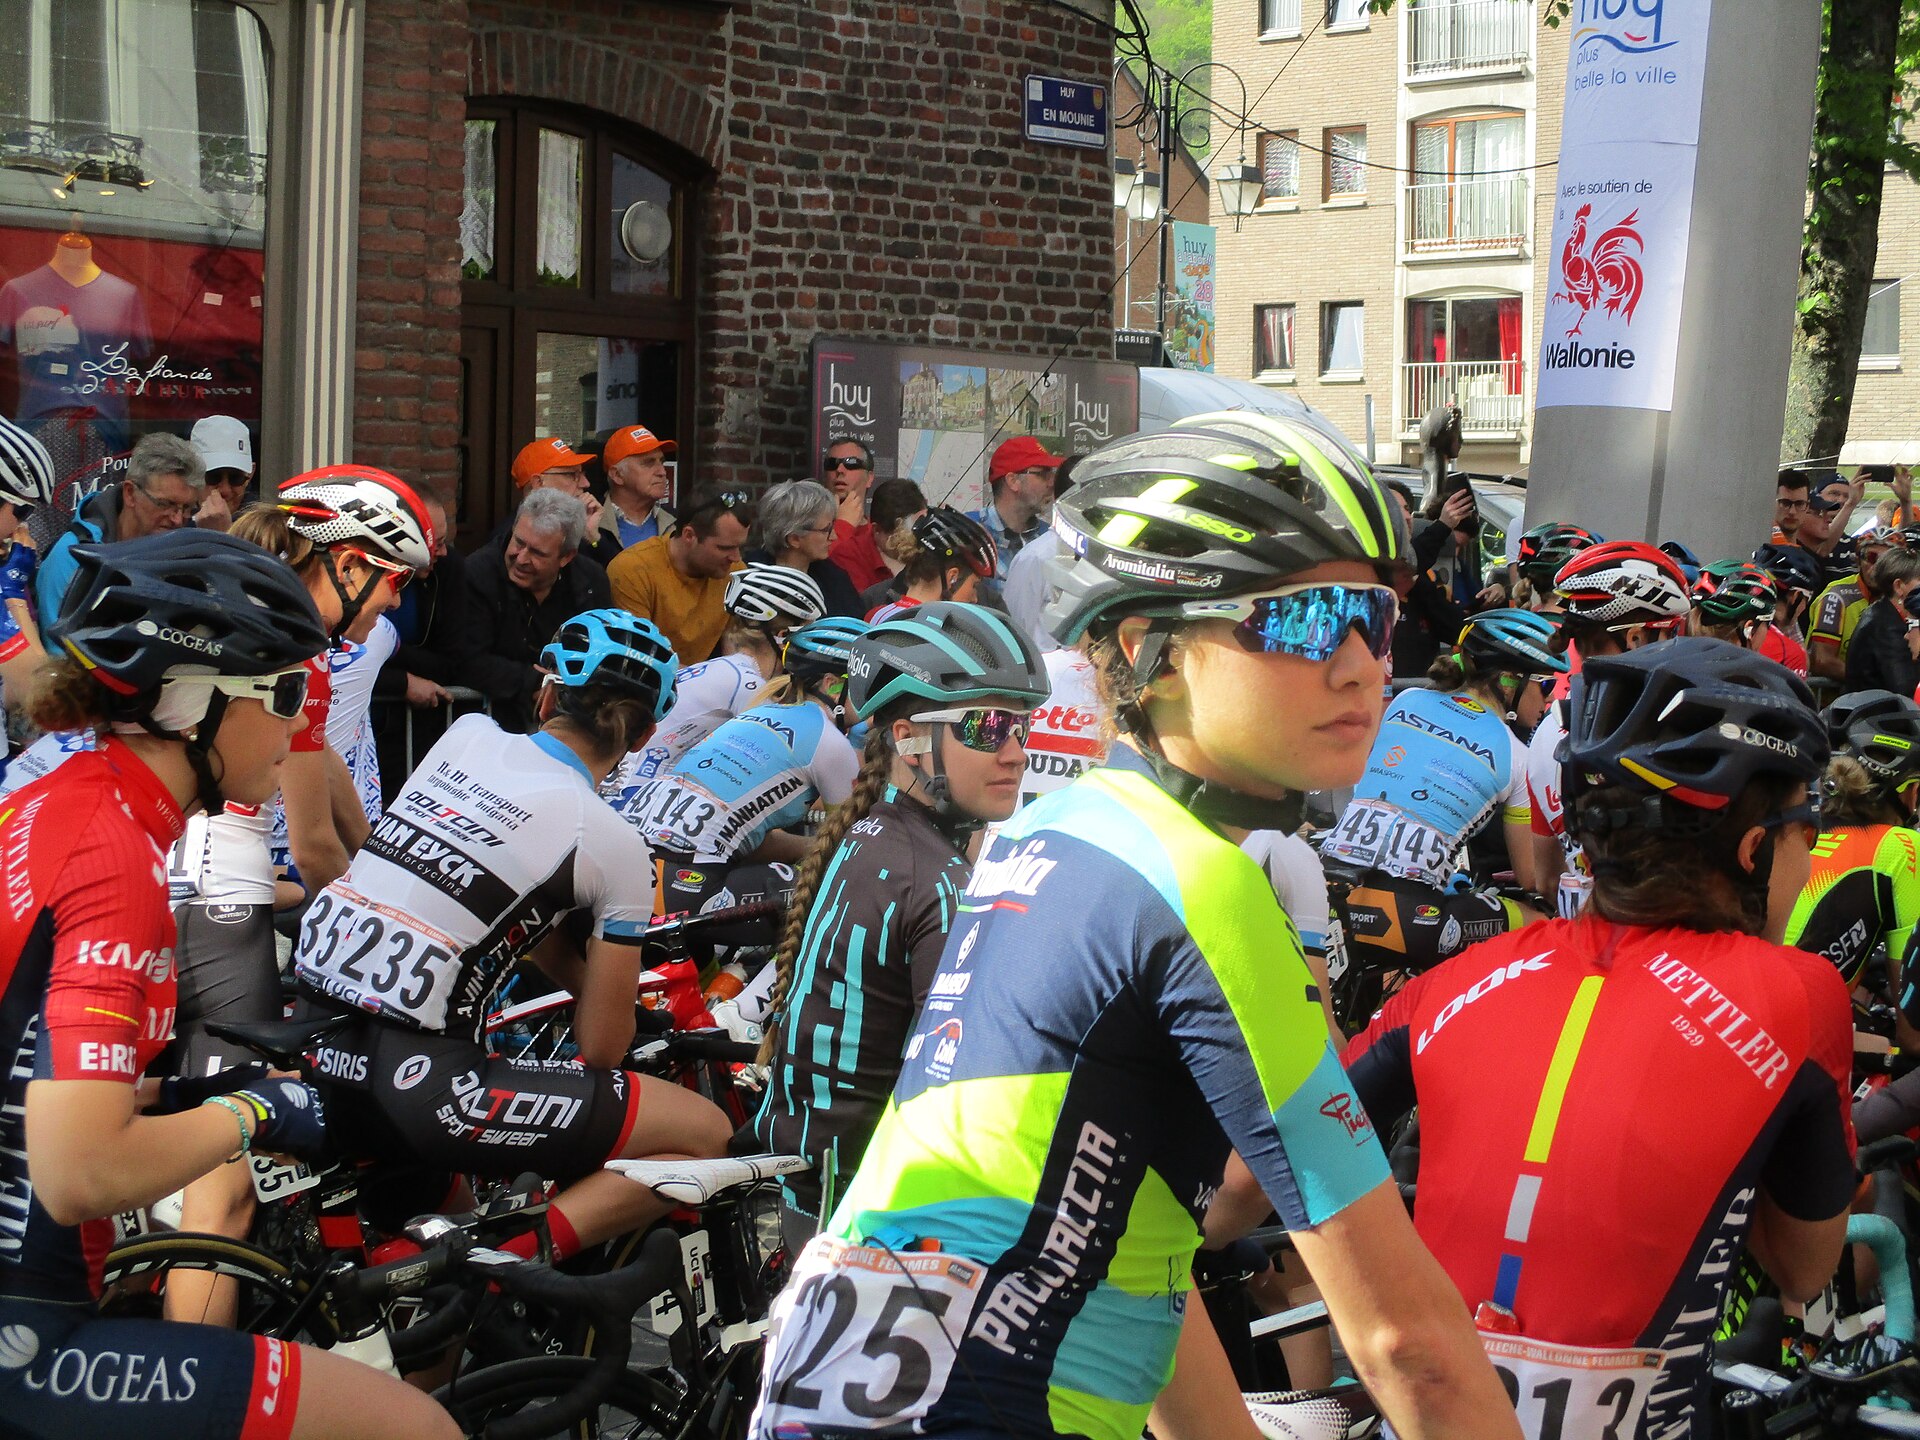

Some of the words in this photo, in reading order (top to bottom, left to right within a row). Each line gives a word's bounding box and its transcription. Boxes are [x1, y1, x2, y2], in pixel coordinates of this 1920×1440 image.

[1576, 48, 1599, 69] plus
[1060, 86, 1076, 98] HUY
[1574, 71, 1604, 91] belle
[1611, 68, 1627, 84] la
[1636, 66, 1677, 84] ville
[1043, 108, 1057, 122] EN
[1060, 110, 1095, 127] MOUNIE
[1578, 182, 1586, 195] le
[1587, 179, 1630, 195] soutien
[1634, 179, 1653, 193] de
[1183, 236, 1208, 256] huy
[1195, 280, 1213, 302] 28
[1545, 341, 1636, 370] Wallonie
[829, 362, 871, 421] huy
[1075, 383, 1110, 438] huy
[338, 498, 419, 552] HJC
[1103, 553, 1176, 580] Aromitalia
[159, 627, 223, 657] COGEAS
[1386, 709, 1496, 772] ASTANA
[1743, 731, 1798, 758] COGEAS
[1857, 755, 1900, 777] RUDY
[469, 783, 534, 823] transport
[475, 800, 520, 832] bulgaria
[652, 787, 716, 838] 143
[718, 776, 804, 843] MANHATTAN
[372, 815, 416, 848] VAN
[407, 834, 485, 888] EYCK
[366, 837, 400, 858] concept
[400, 852, 417, 866] for
[416, 864, 463, 898] cycling
[338, 915, 451, 1010] 235
[332, 983, 362, 1005] UCI
[1416, 948, 1557, 1055] LOOK
[1642, 950, 1790, 1090] METTLER
[1669, 1013, 1705, 1048] 1929
[690, 1246, 699, 1272] UCI
[1591, 1354, 1639, 1367] FEMMES
